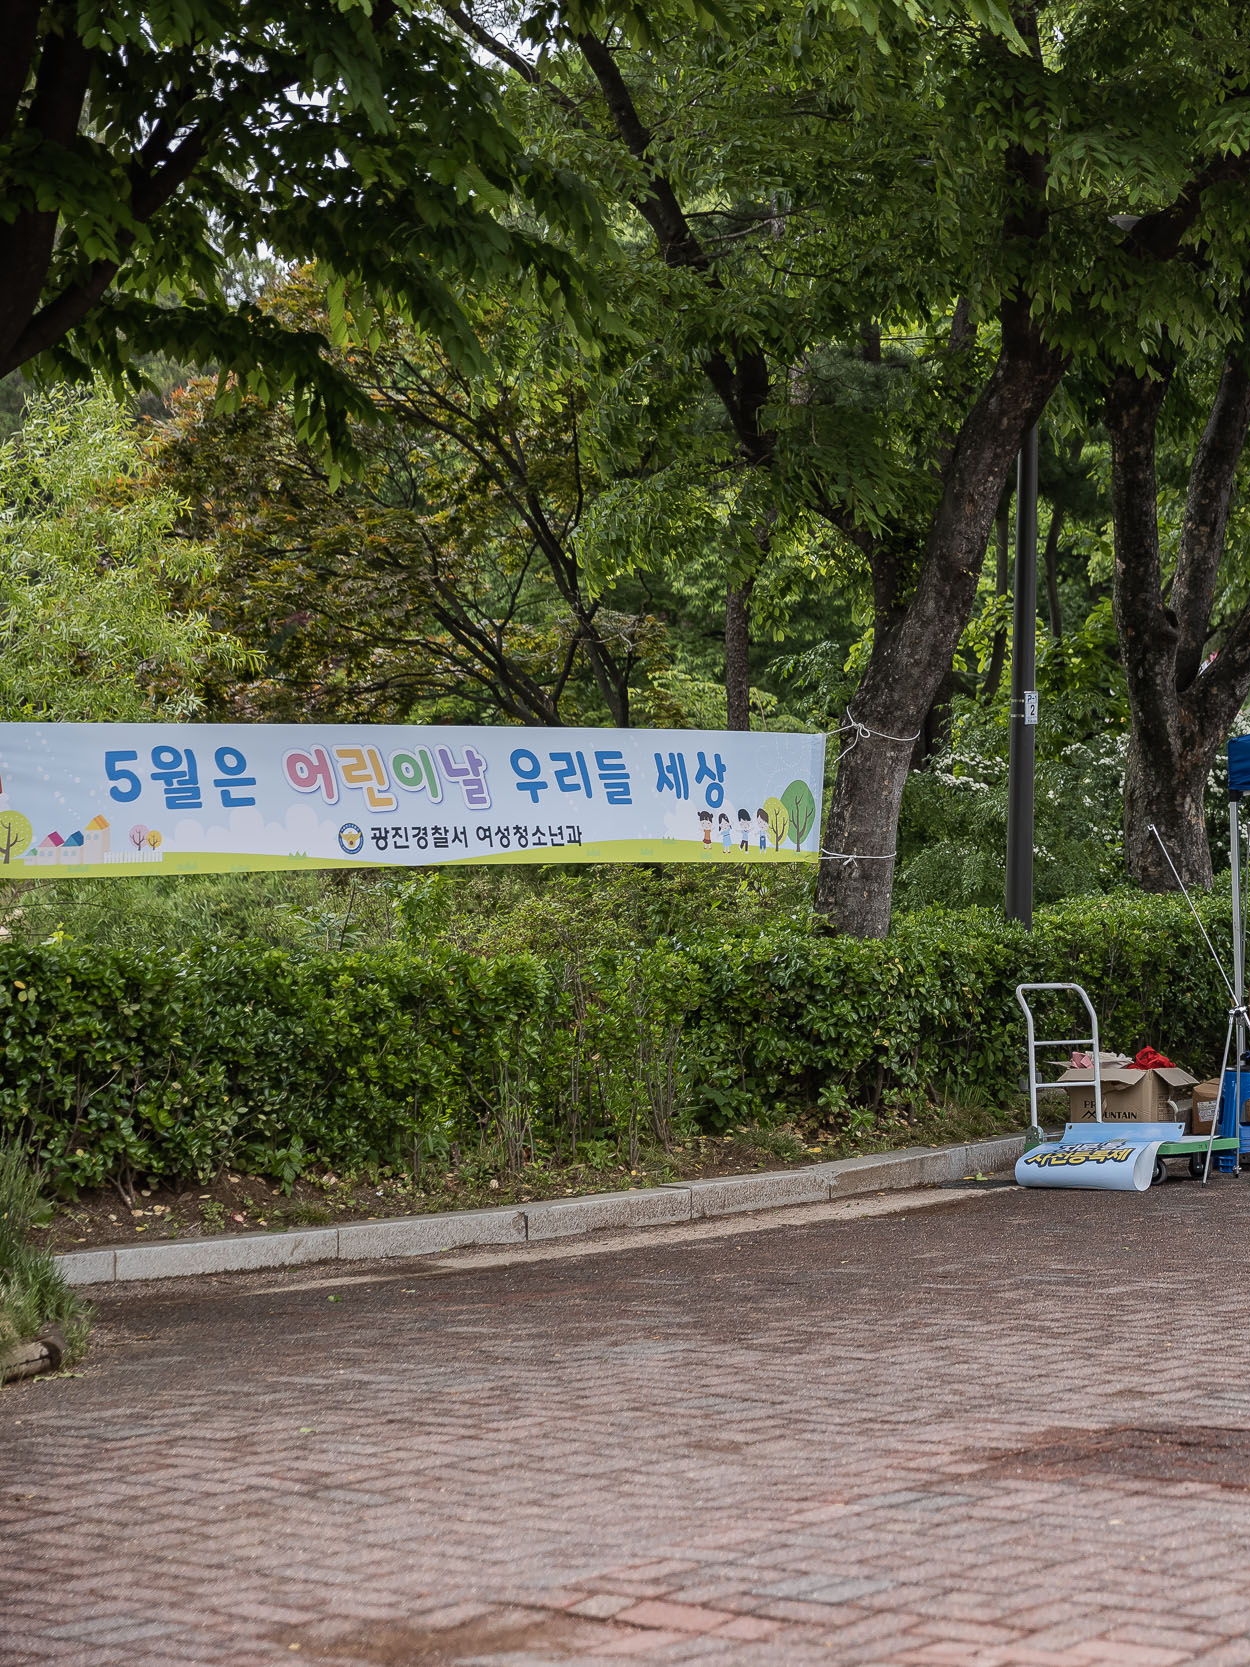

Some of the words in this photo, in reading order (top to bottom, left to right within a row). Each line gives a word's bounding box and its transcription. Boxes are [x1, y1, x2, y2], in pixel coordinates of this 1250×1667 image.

[104, 745, 257, 810] 5월은
[284, 746, 490, 811] 어린이날
[510, 748, 633, 805] 우리들
[653, 751, 727, 809] 세상
[370, 824, 469, 851] 광진경찰서
[476, 824, 583, 849] 여성청소년과
[1081, 1110, 1138, 1120] MUNTAIN
[1026, 1148, 1134, 1166] 사전등록제
